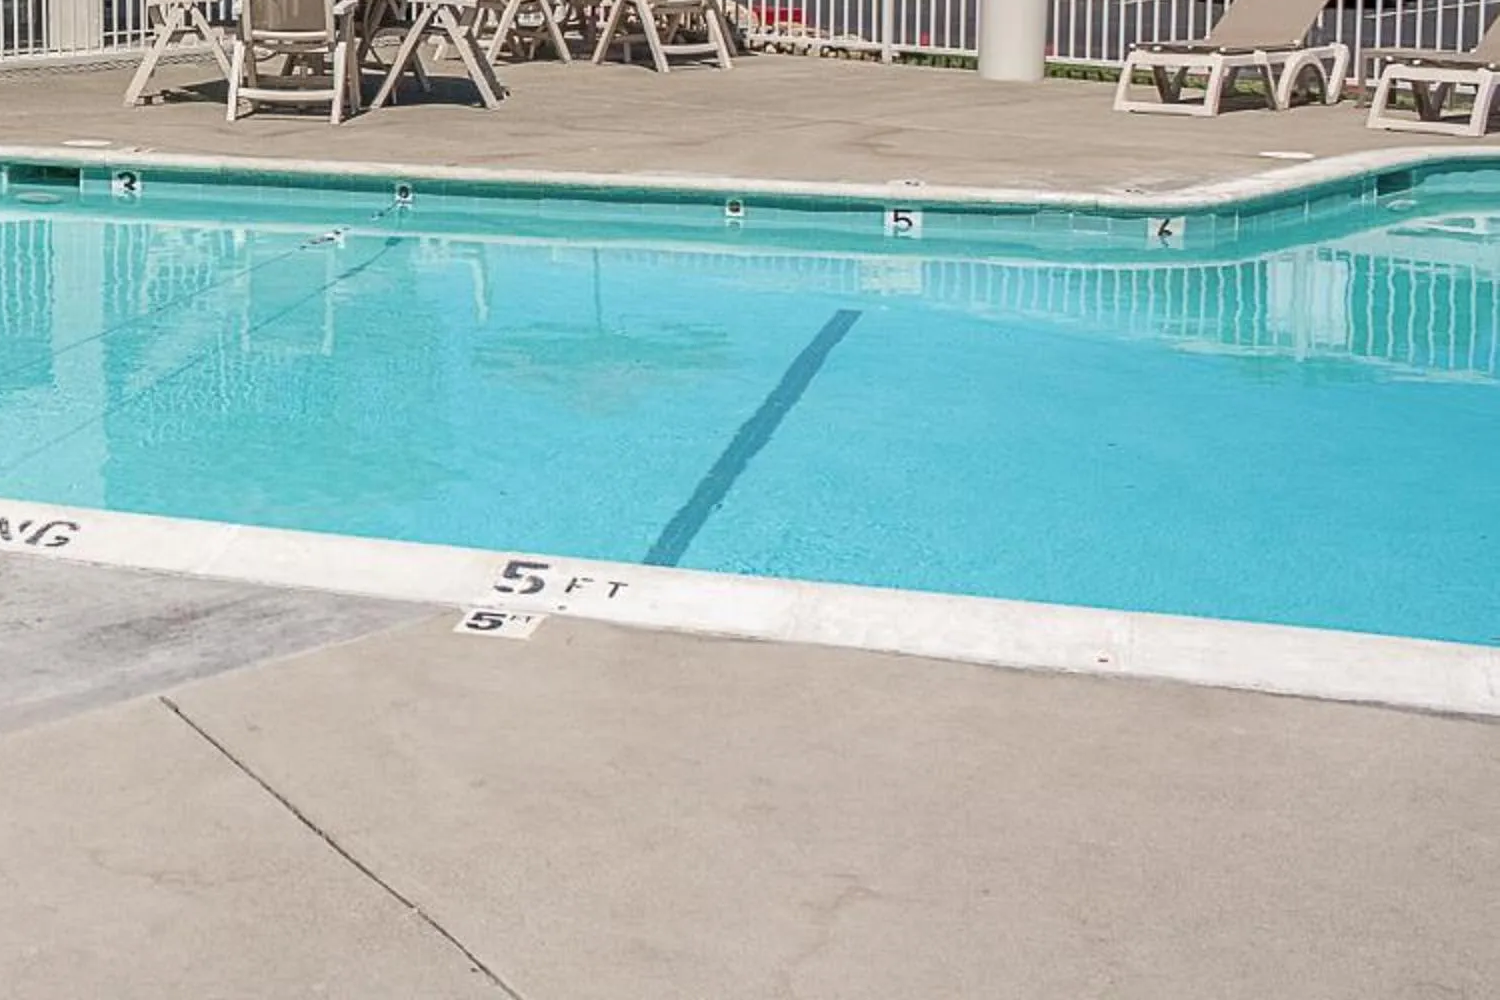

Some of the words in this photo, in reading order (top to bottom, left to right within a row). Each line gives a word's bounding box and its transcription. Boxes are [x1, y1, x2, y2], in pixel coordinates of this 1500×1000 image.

[892, 208, 913, 228] 5
[492, 559, 550, 595] 5
[564, 577, 629, 599] FT
[465, 611, 507, 631] 5
